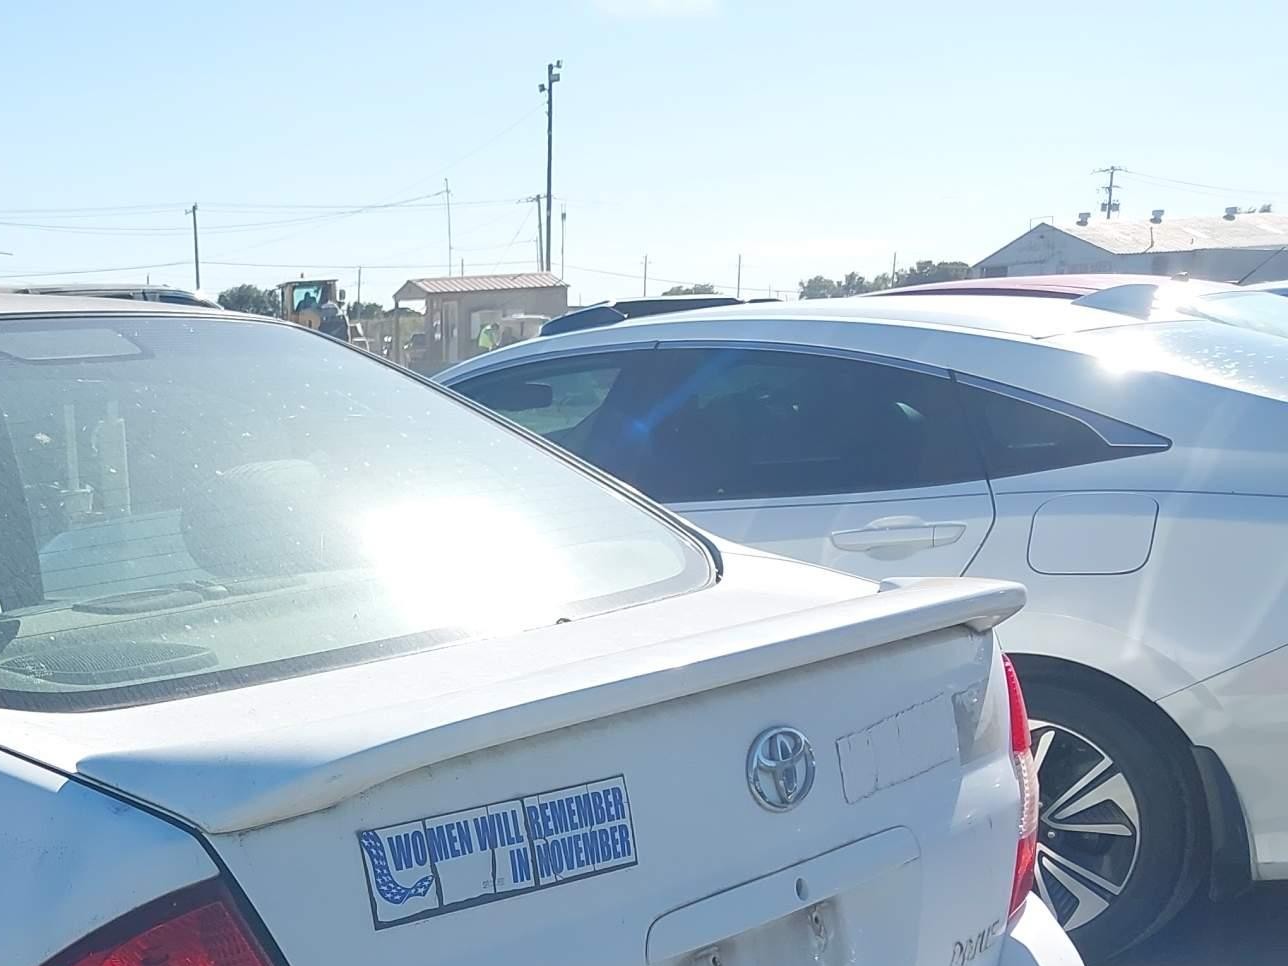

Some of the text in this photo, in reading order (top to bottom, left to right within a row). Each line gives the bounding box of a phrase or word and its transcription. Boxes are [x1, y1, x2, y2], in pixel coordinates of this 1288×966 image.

[387, 786, 627, 871] WOMEN WILL REMEMBER
[510, 823, 632, 883] IN NOVEMBER
